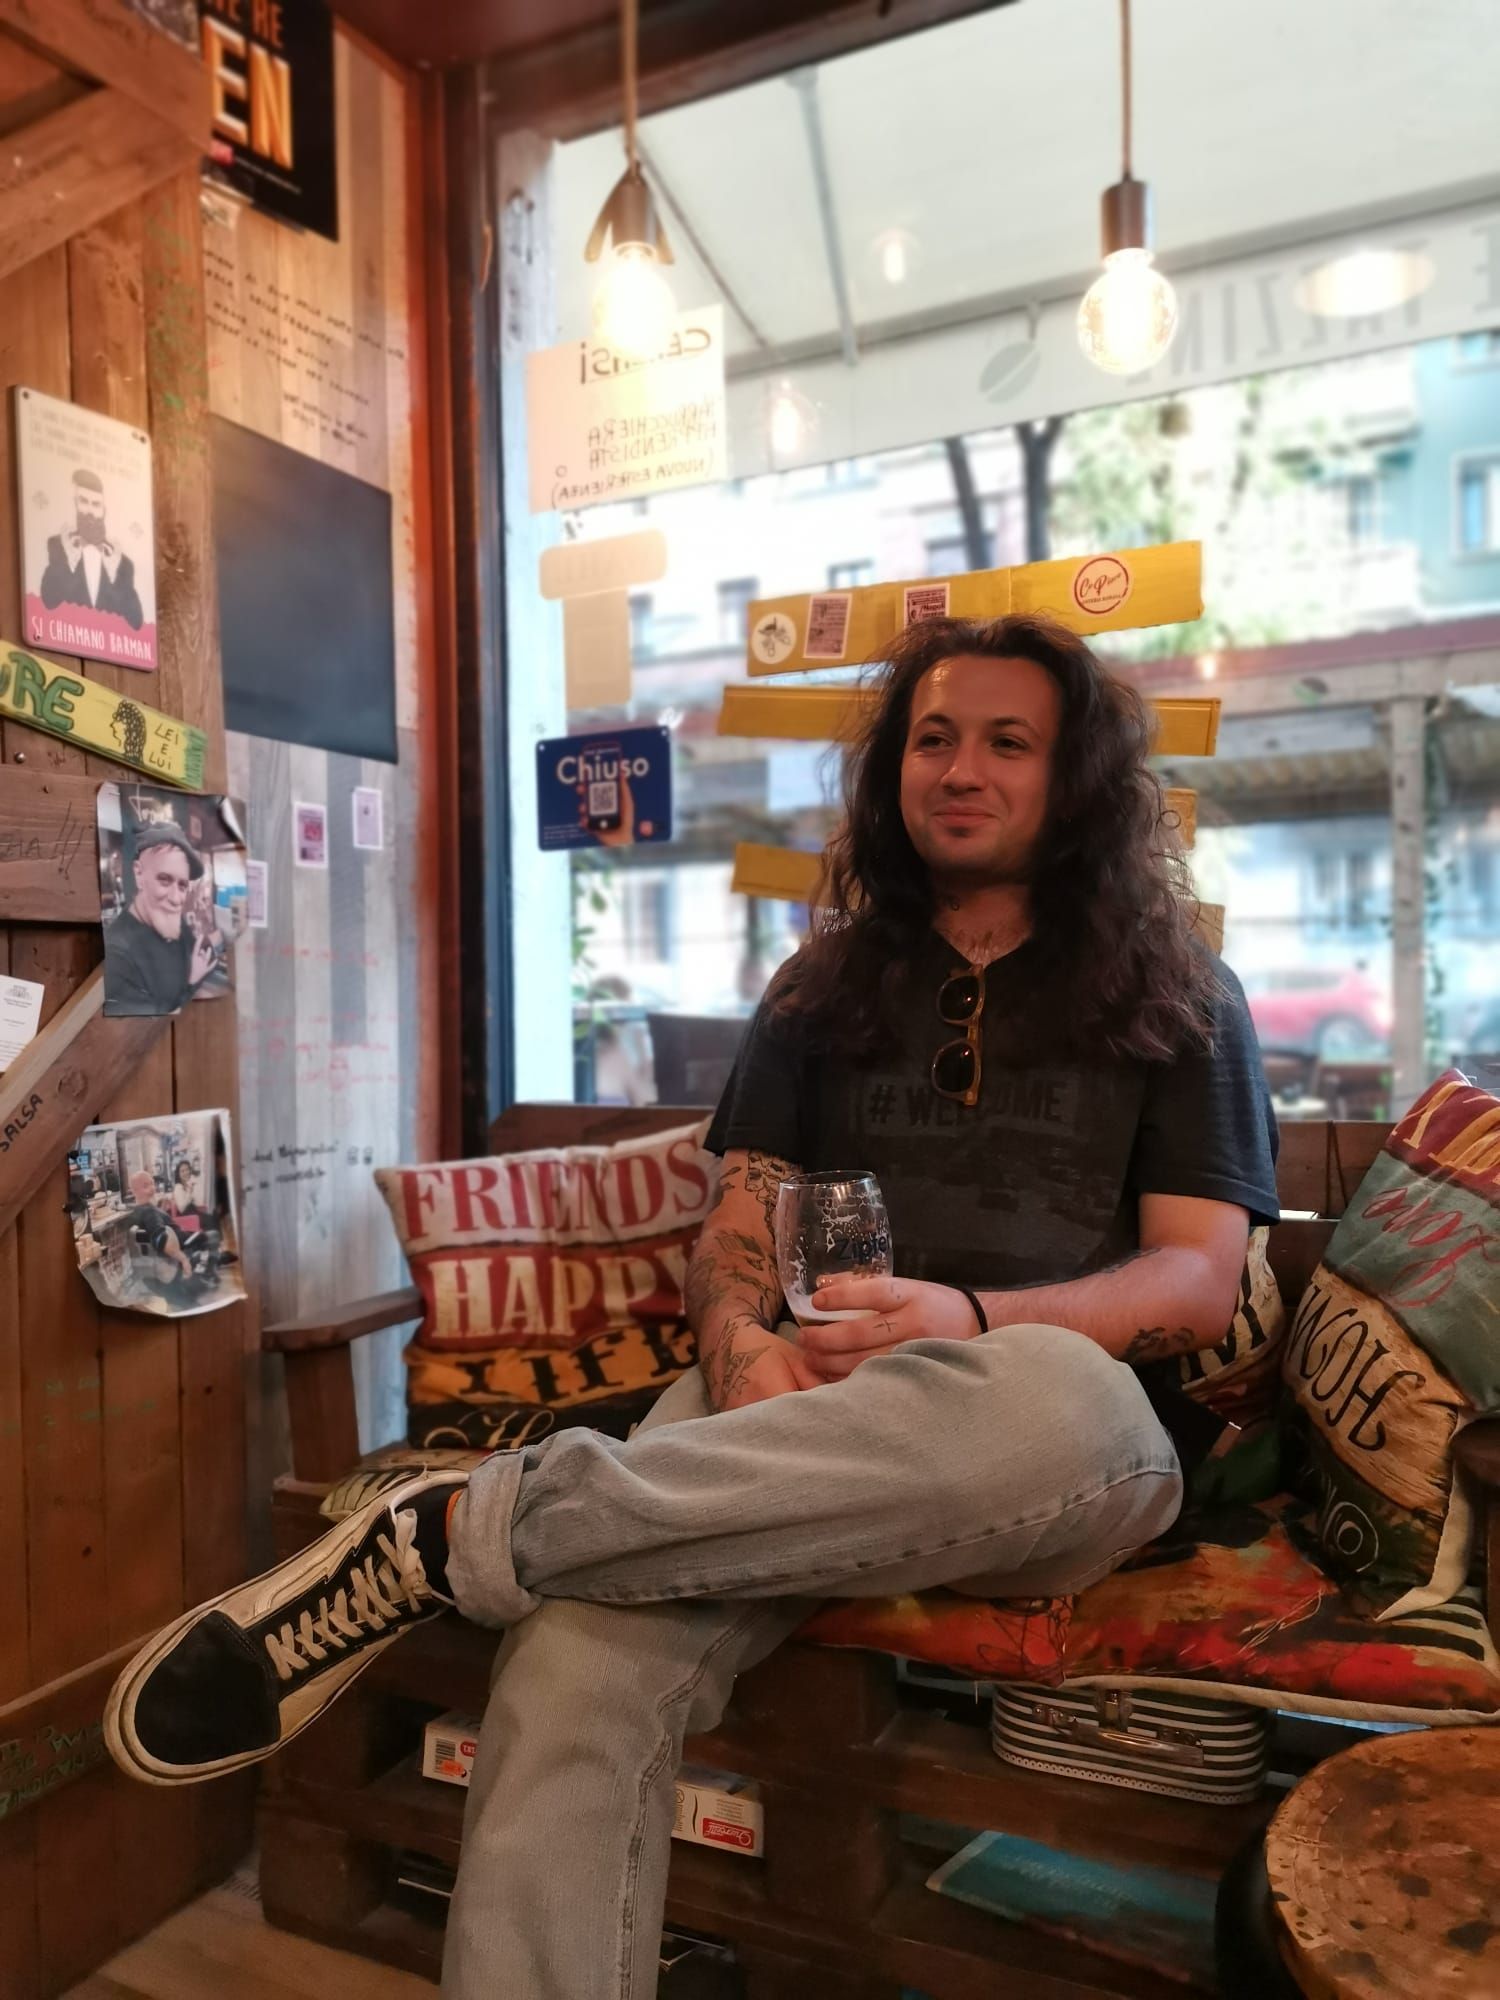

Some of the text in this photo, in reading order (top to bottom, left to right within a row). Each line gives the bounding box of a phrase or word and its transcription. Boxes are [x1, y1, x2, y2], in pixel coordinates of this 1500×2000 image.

[49, 619, 106, 651] CHIAMANO
[109, 632, 153, 661] BARMAN
[556, 755, 650, 785] Chiuso
[400, 1136, 709, 1242] FRIENDS
[838, 1231, 891, 1265] Zipfe
